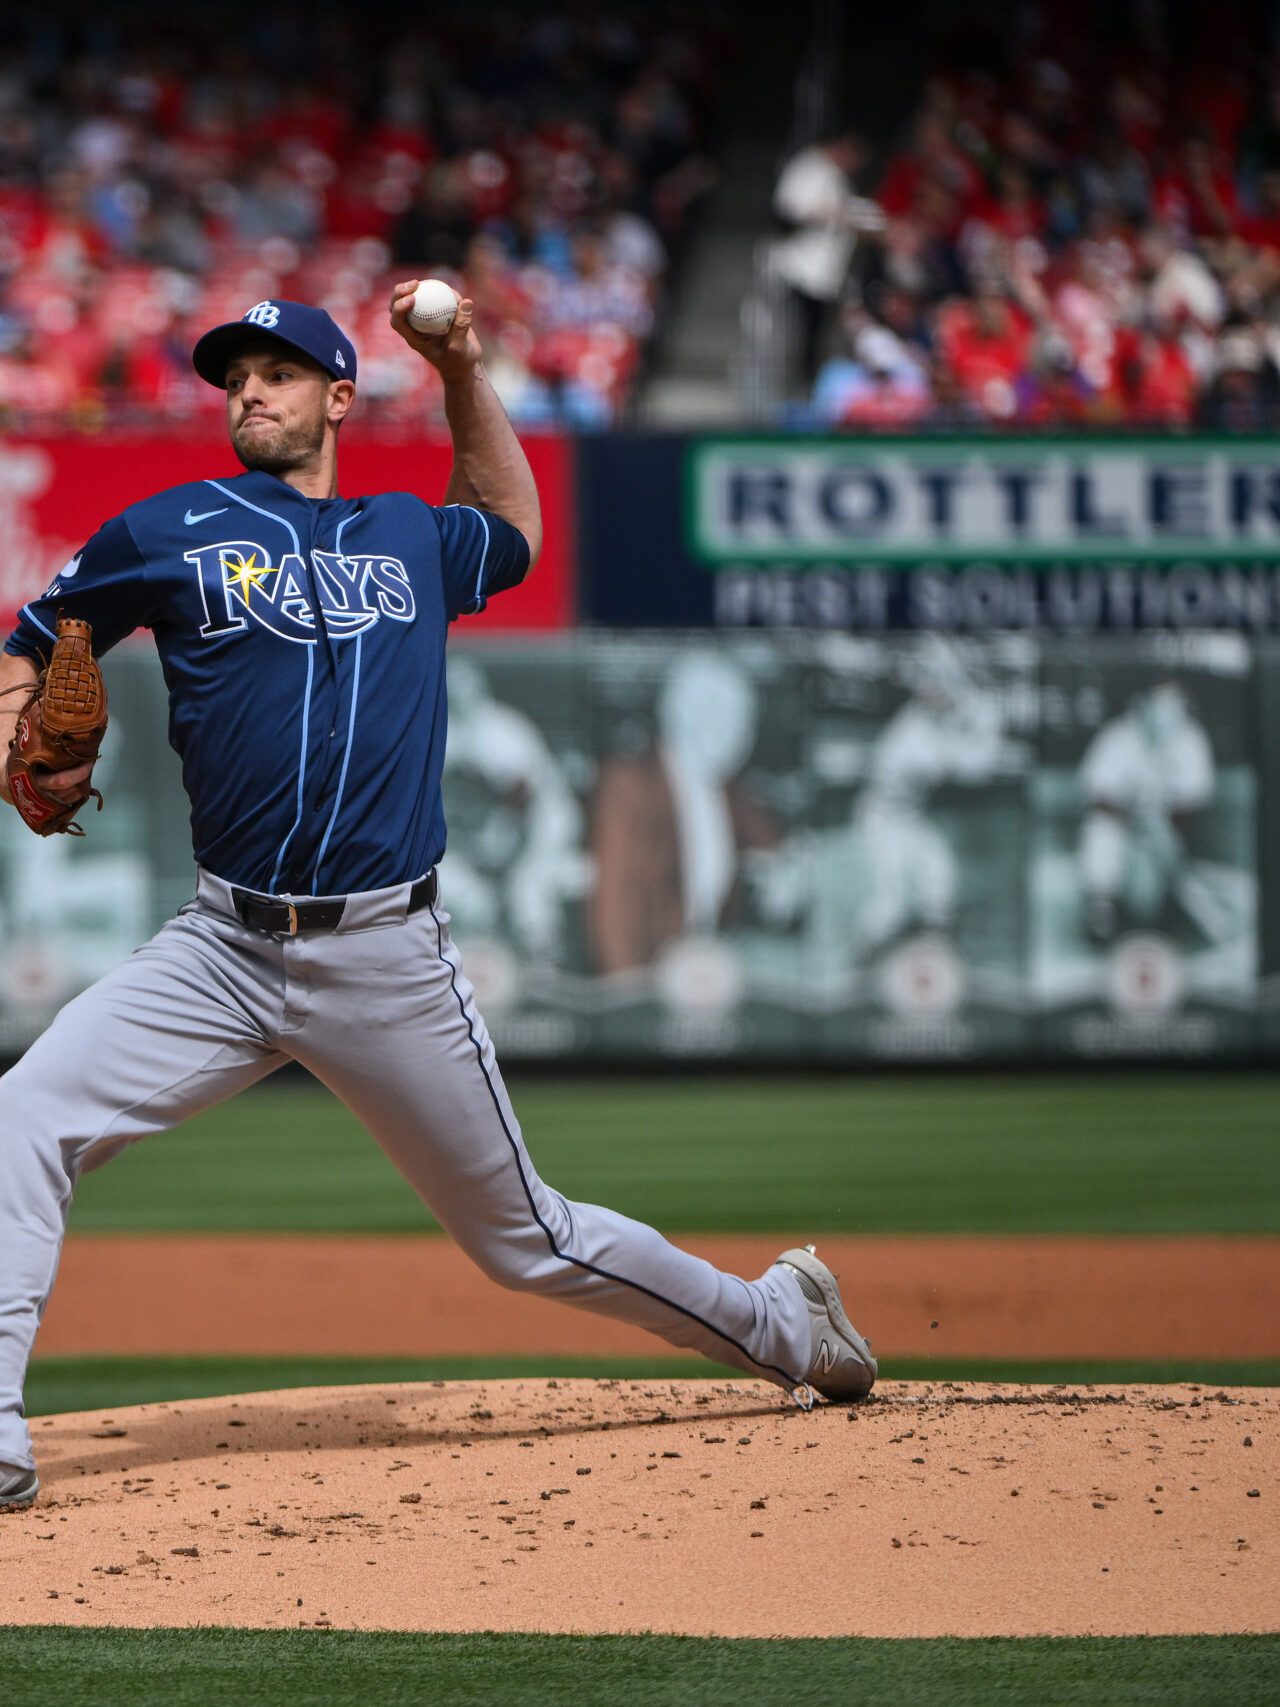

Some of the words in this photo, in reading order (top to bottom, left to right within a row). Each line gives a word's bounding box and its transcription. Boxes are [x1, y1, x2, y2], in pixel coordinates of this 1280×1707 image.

[245, 300, 280, 328] TB
[724, 464, 1280, 536] ROTTLER
[183, 540, 417, 645] RAYS
[715, 566, 888, 626] PEST
